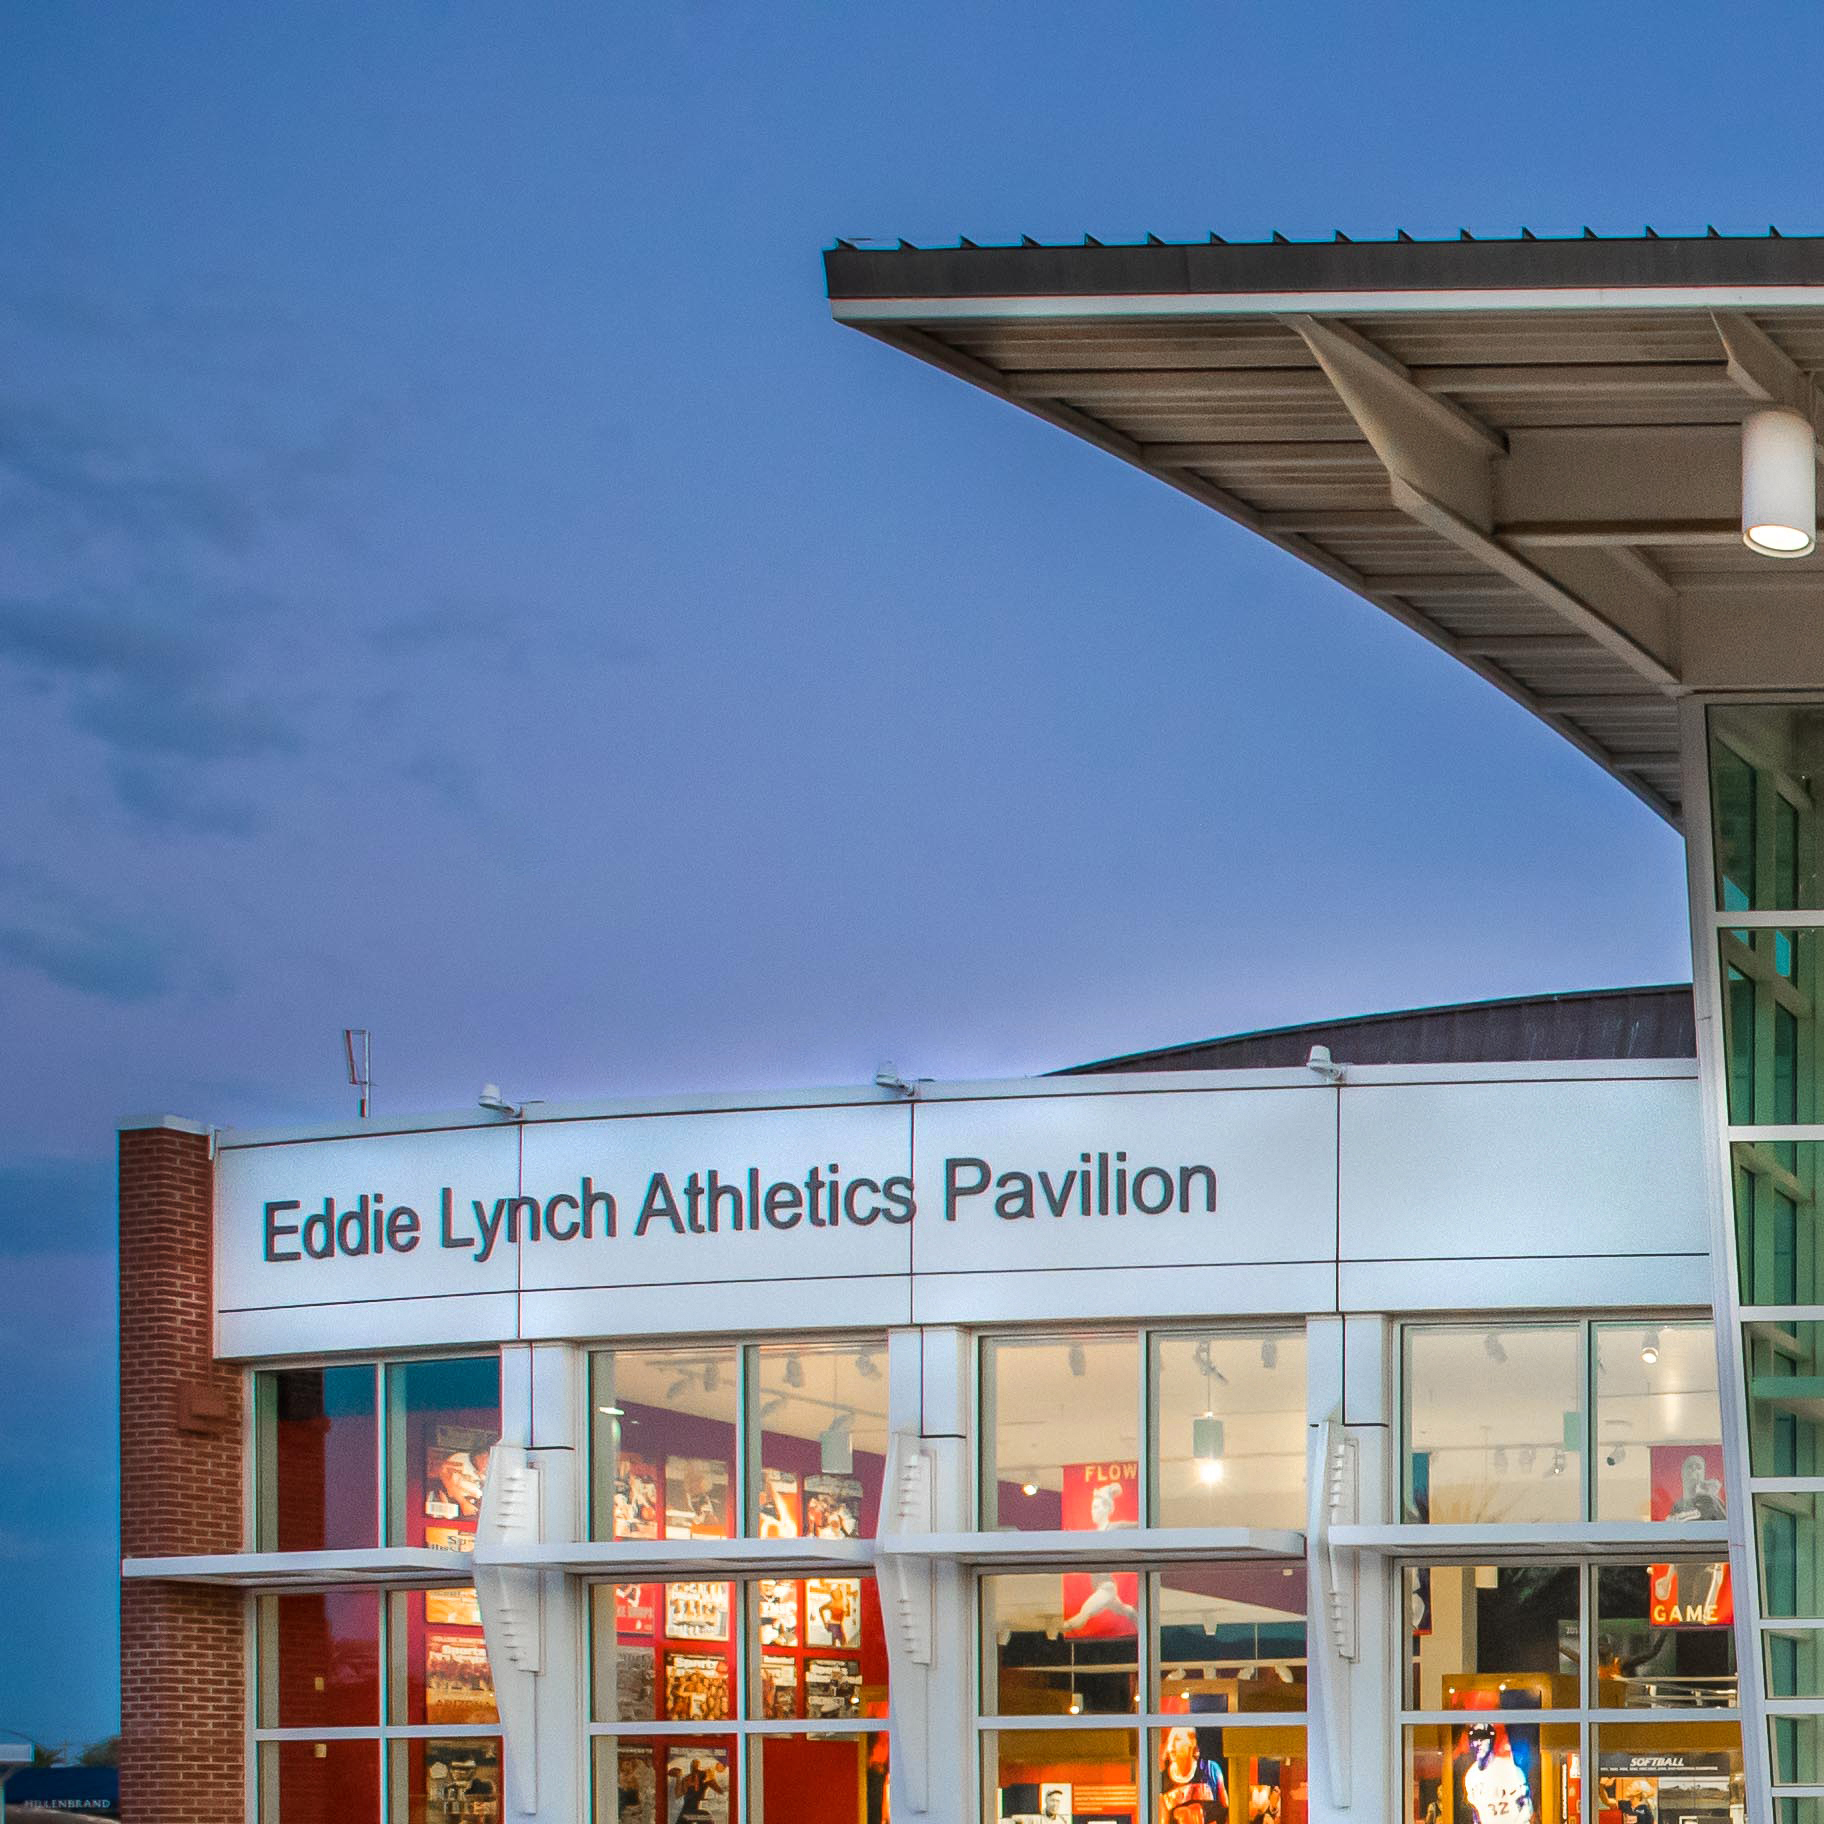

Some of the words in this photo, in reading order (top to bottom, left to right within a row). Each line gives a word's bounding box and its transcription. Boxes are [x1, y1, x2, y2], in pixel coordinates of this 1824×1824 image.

[264, 1192, 421, 1262] Eddie
[440, 1177, 617, 1264] Lynch
[635, 1162, 916, 1237] Athletics
[945, 1150, 1218, 1222] Pavilion
[1085, 1464, 1138, 1482] FLOW
[1654, 1605, 1719, 1624] GAME
[1630, 1757, 1684, 1767] SOFTBALL
